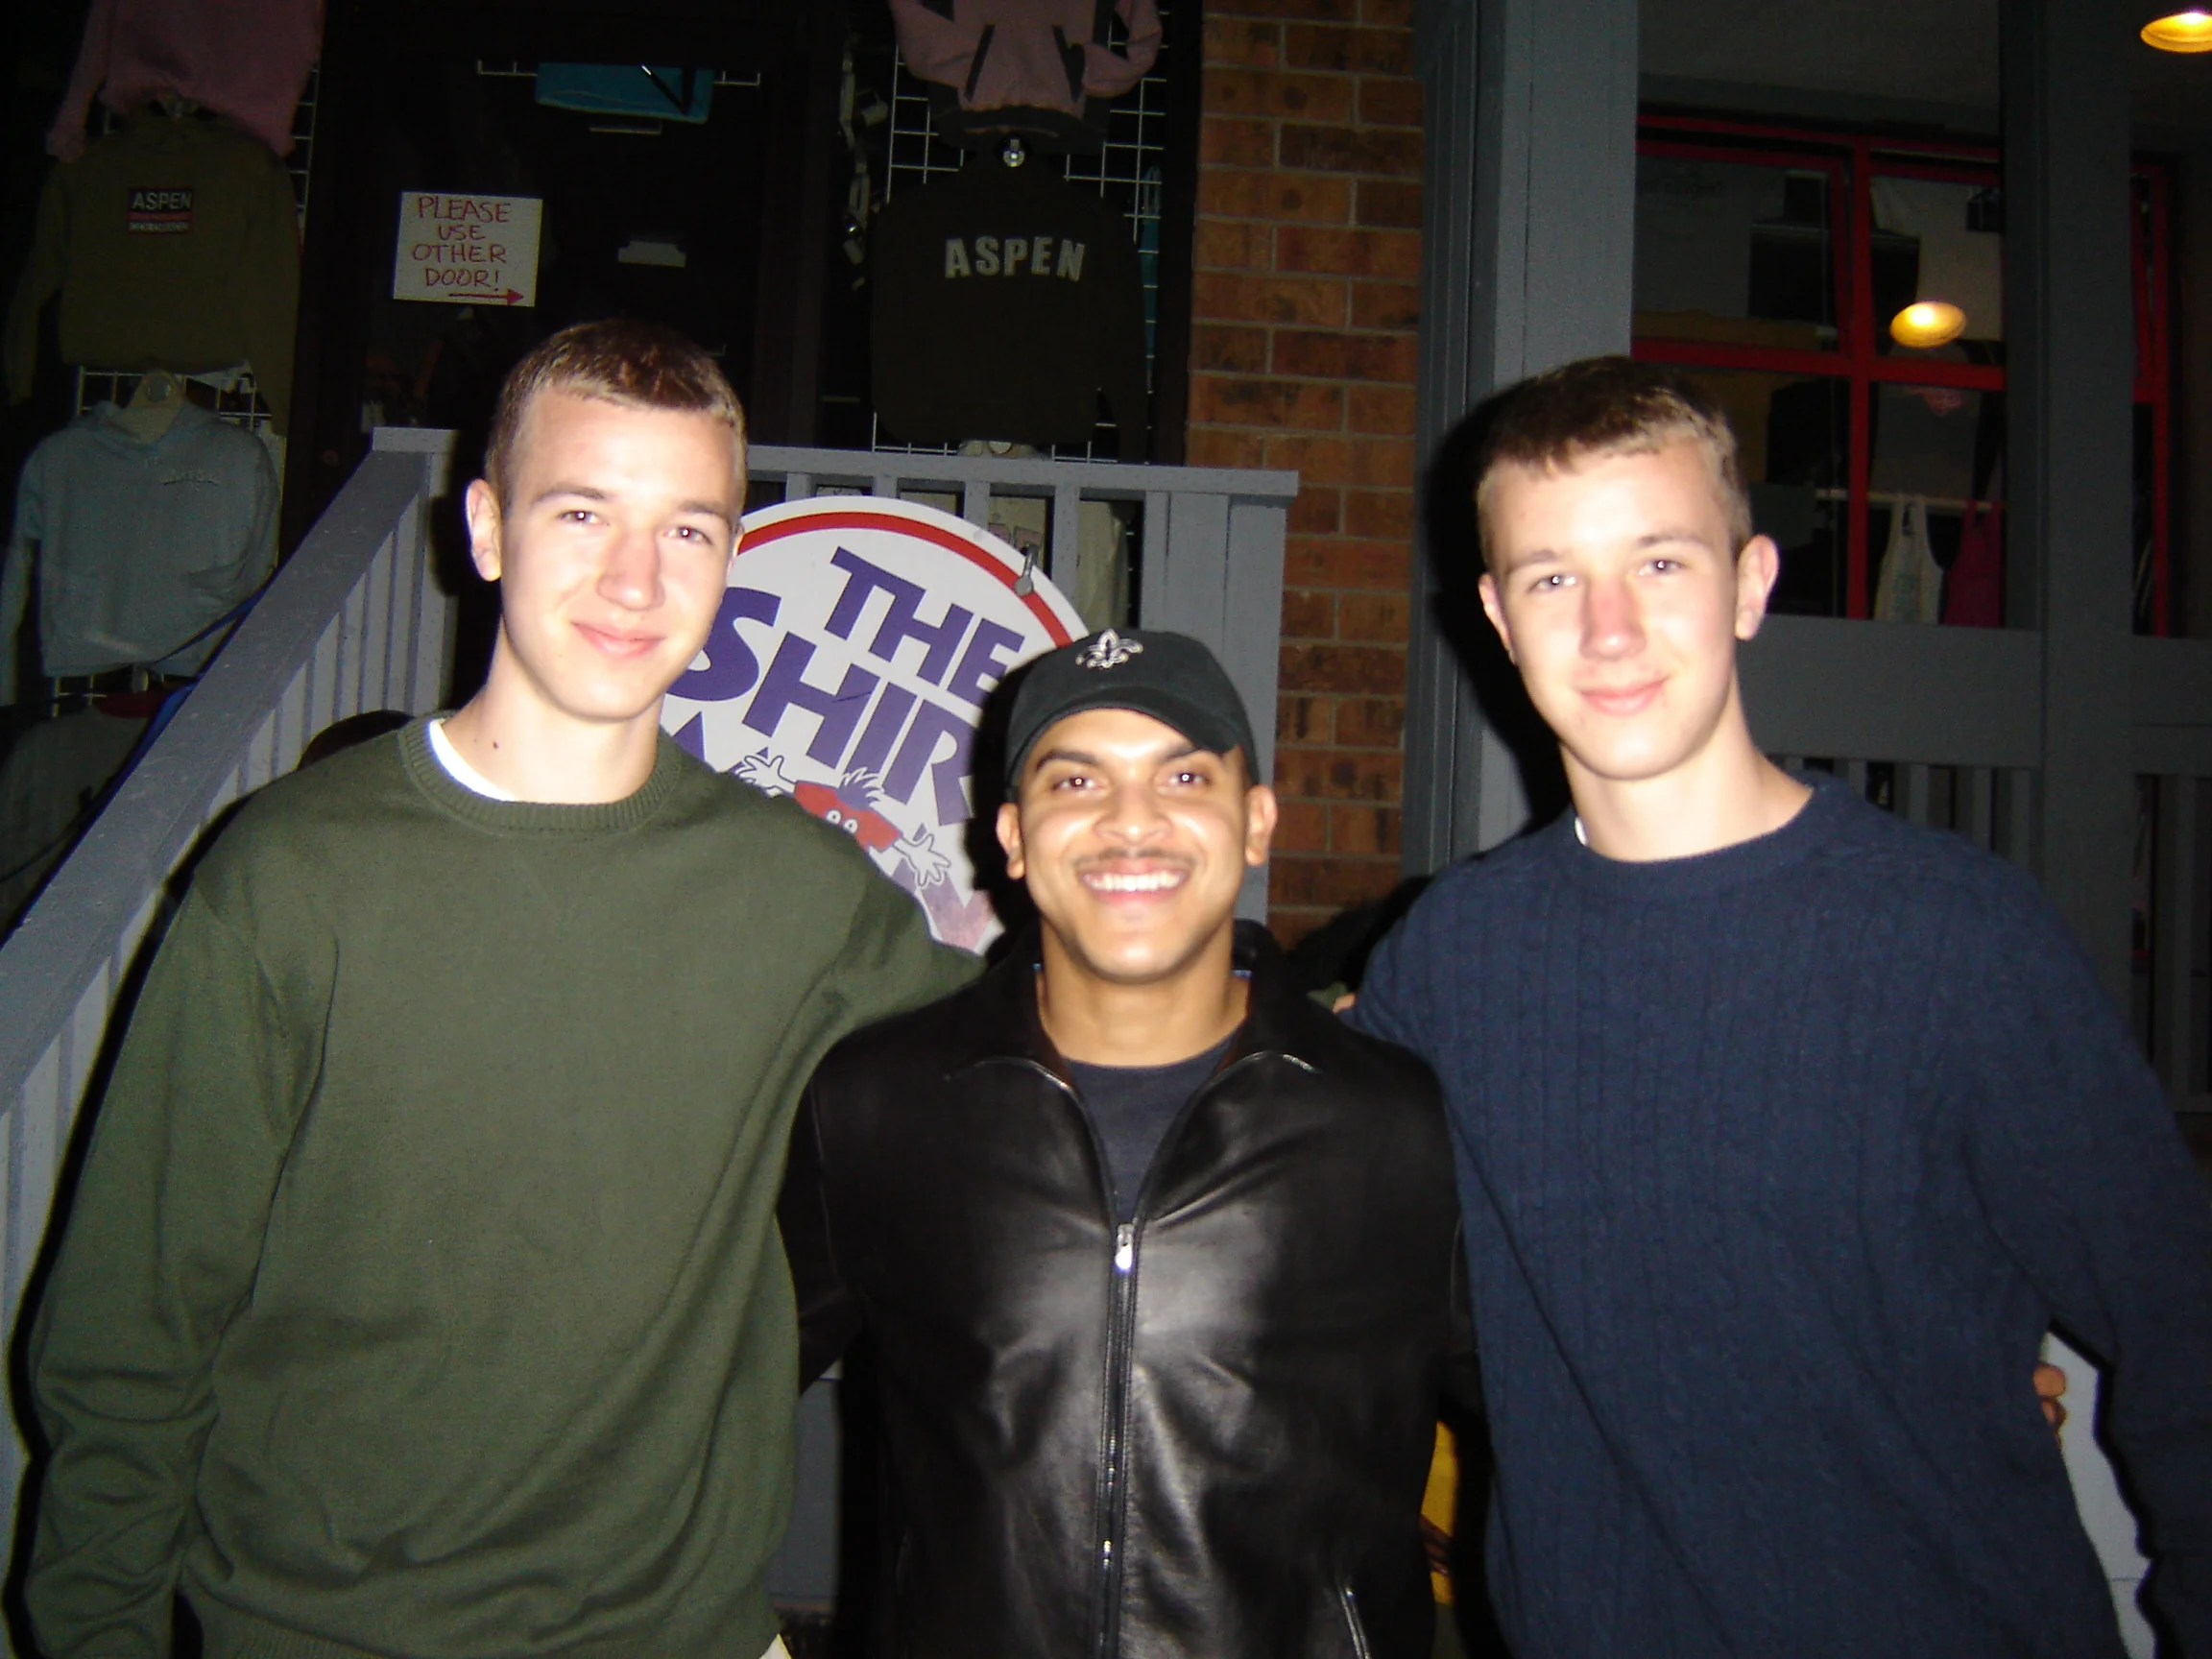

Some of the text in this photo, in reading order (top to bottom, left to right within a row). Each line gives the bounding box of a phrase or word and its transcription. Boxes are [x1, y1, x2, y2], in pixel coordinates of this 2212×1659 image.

[132, 191, 192, 210] ASPEN
[419, 196, 511, 223] PLEASE
[439, 225, 485, 240] USE
[413, 243, 506, 264] OTHER
[945, 235, 1086, 282] ASPEN
[425, 268, 499, 292] DOOR!
[825, 545, 1025, 708] THE
